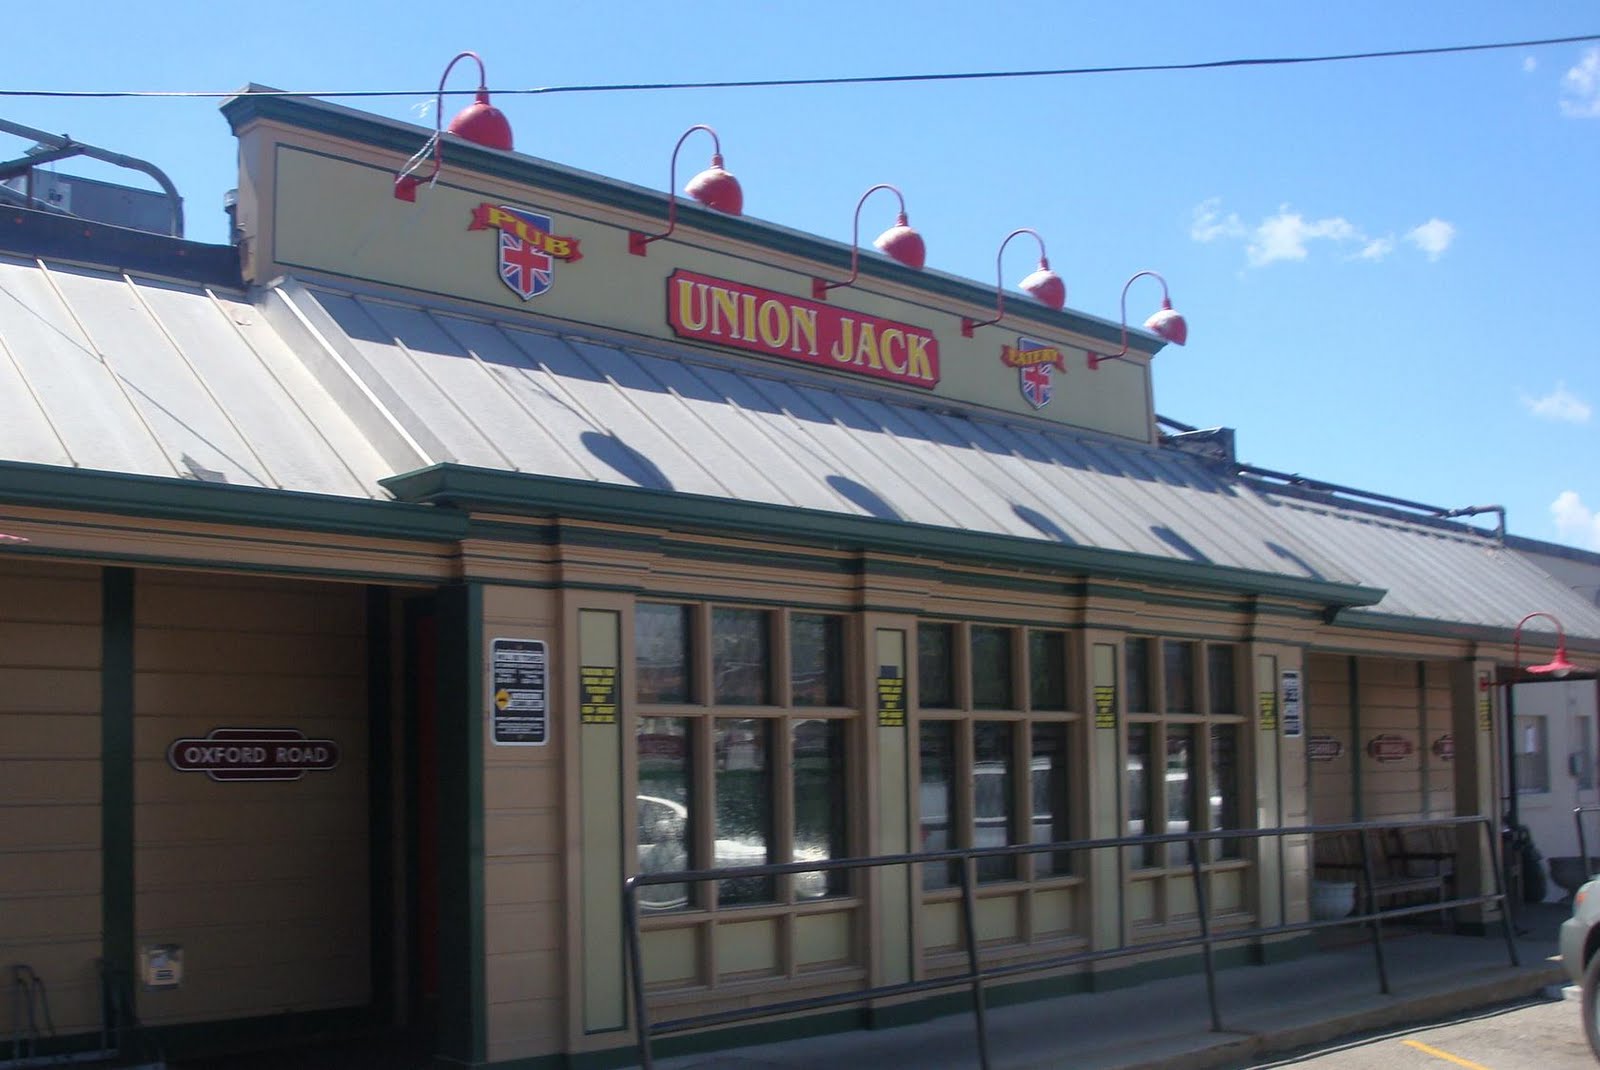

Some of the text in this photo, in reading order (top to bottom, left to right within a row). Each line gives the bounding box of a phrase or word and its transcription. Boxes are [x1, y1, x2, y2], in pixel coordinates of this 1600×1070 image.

[488, 207, 571, 256] PUB
[676, 279, 935, 381] UNION JACK
[184, 747, 329, 763] OXFORD ROAD
